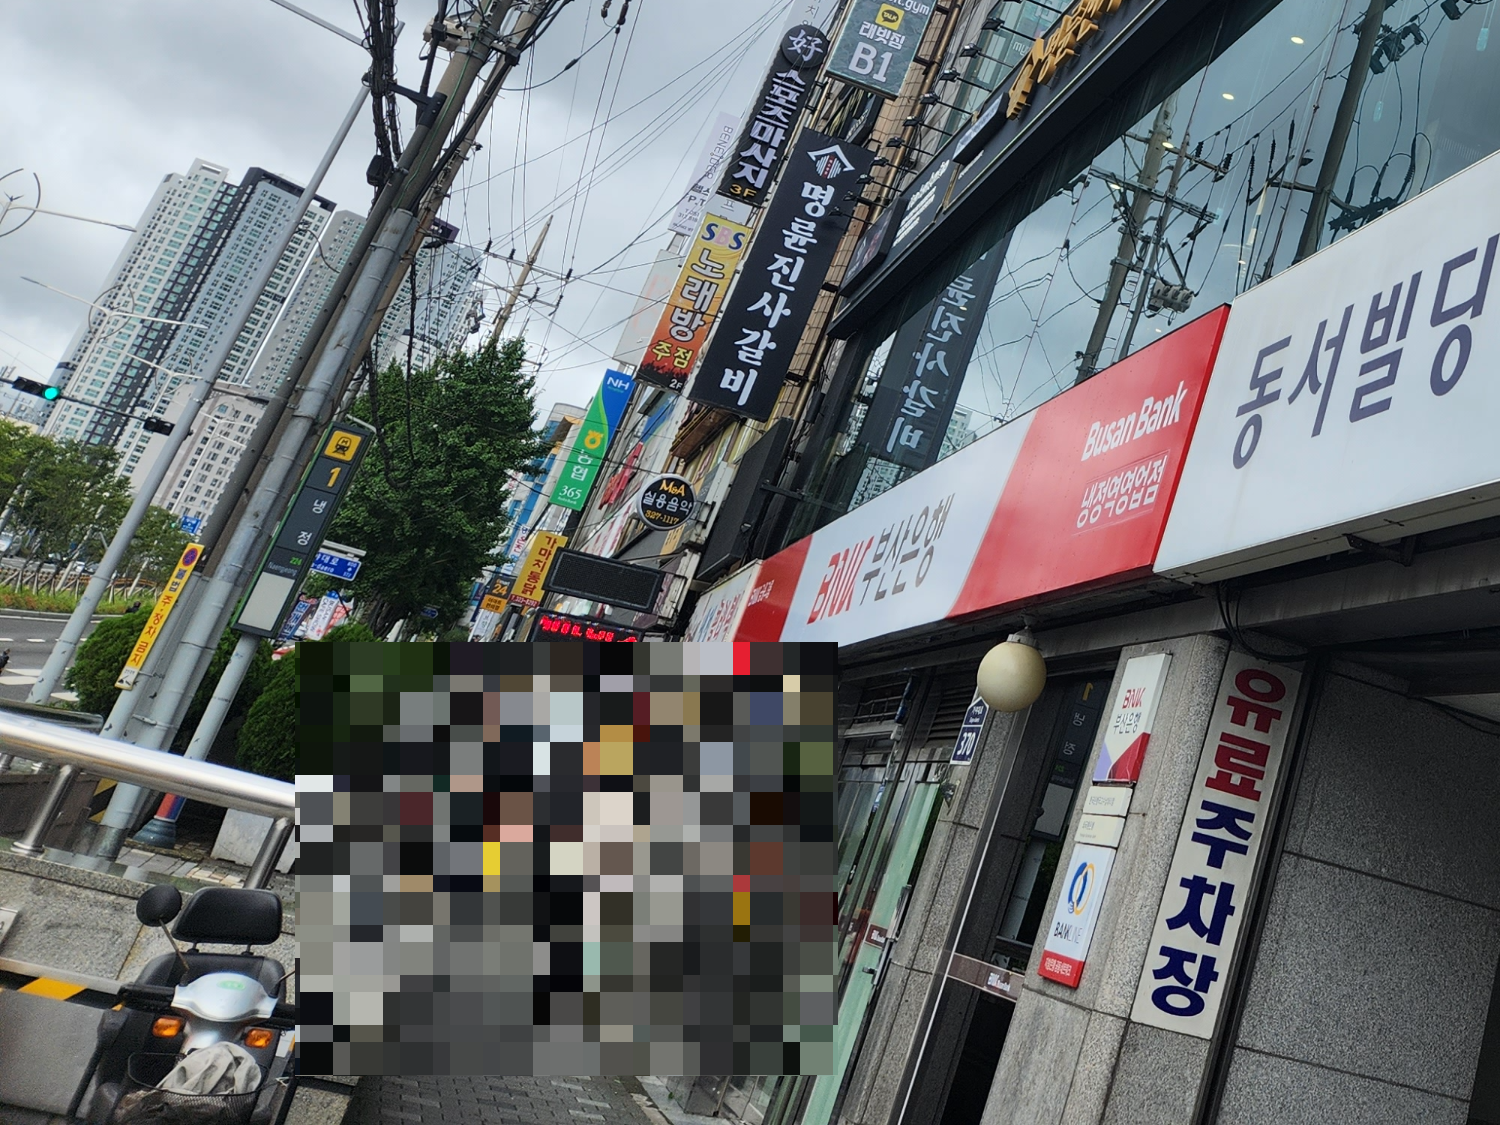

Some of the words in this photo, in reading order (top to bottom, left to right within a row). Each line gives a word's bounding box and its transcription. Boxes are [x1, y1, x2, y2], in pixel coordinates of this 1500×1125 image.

[787, 29, 823, 63] 好
[858, 21, 906, 50] 래빗짐
[848, 41, 893, 83] B1
[731, 69, 806, 190] 스포츠마사지
[729, 183, 757, 198] 3F
[701, 222, 746, 251] SBS
[669, 248, 725, 343] 노래방
[719, 182, 837, 406] 명륜진사갈비
[652, 341, 693, 369] 주점
[606, 376, 630, 390] NH
[669, 378, 684, 390] 2F
[1080, 409, 1135, 463] Busan
[1132, 380, 1187, 442] Bank
[326, 467, 342, 488] 1
[558, 485, 582, 500] 365
[642, 491, 692, 515] 실용음악
[1076, 455, 1169, 529] 냉정역영업점
[297, 498, 328, 546] 냉정
[645, 509, 680, 525] 327-1117
[521, 535, 558, 597] 가마치통닭
[807, 535, 875, 625] BNK
[859, 492, 956, 607] 부산은행
[491, 583, 508, 596] 24
[130, 642, 149, 666] 금지
[1122, 687, 1147, 709] BNK
[1112, 711, 1142, 735] 부산은행
[956, 725, 976, 757] 370
[1053, 921, 1082, 945] BANKLINE
